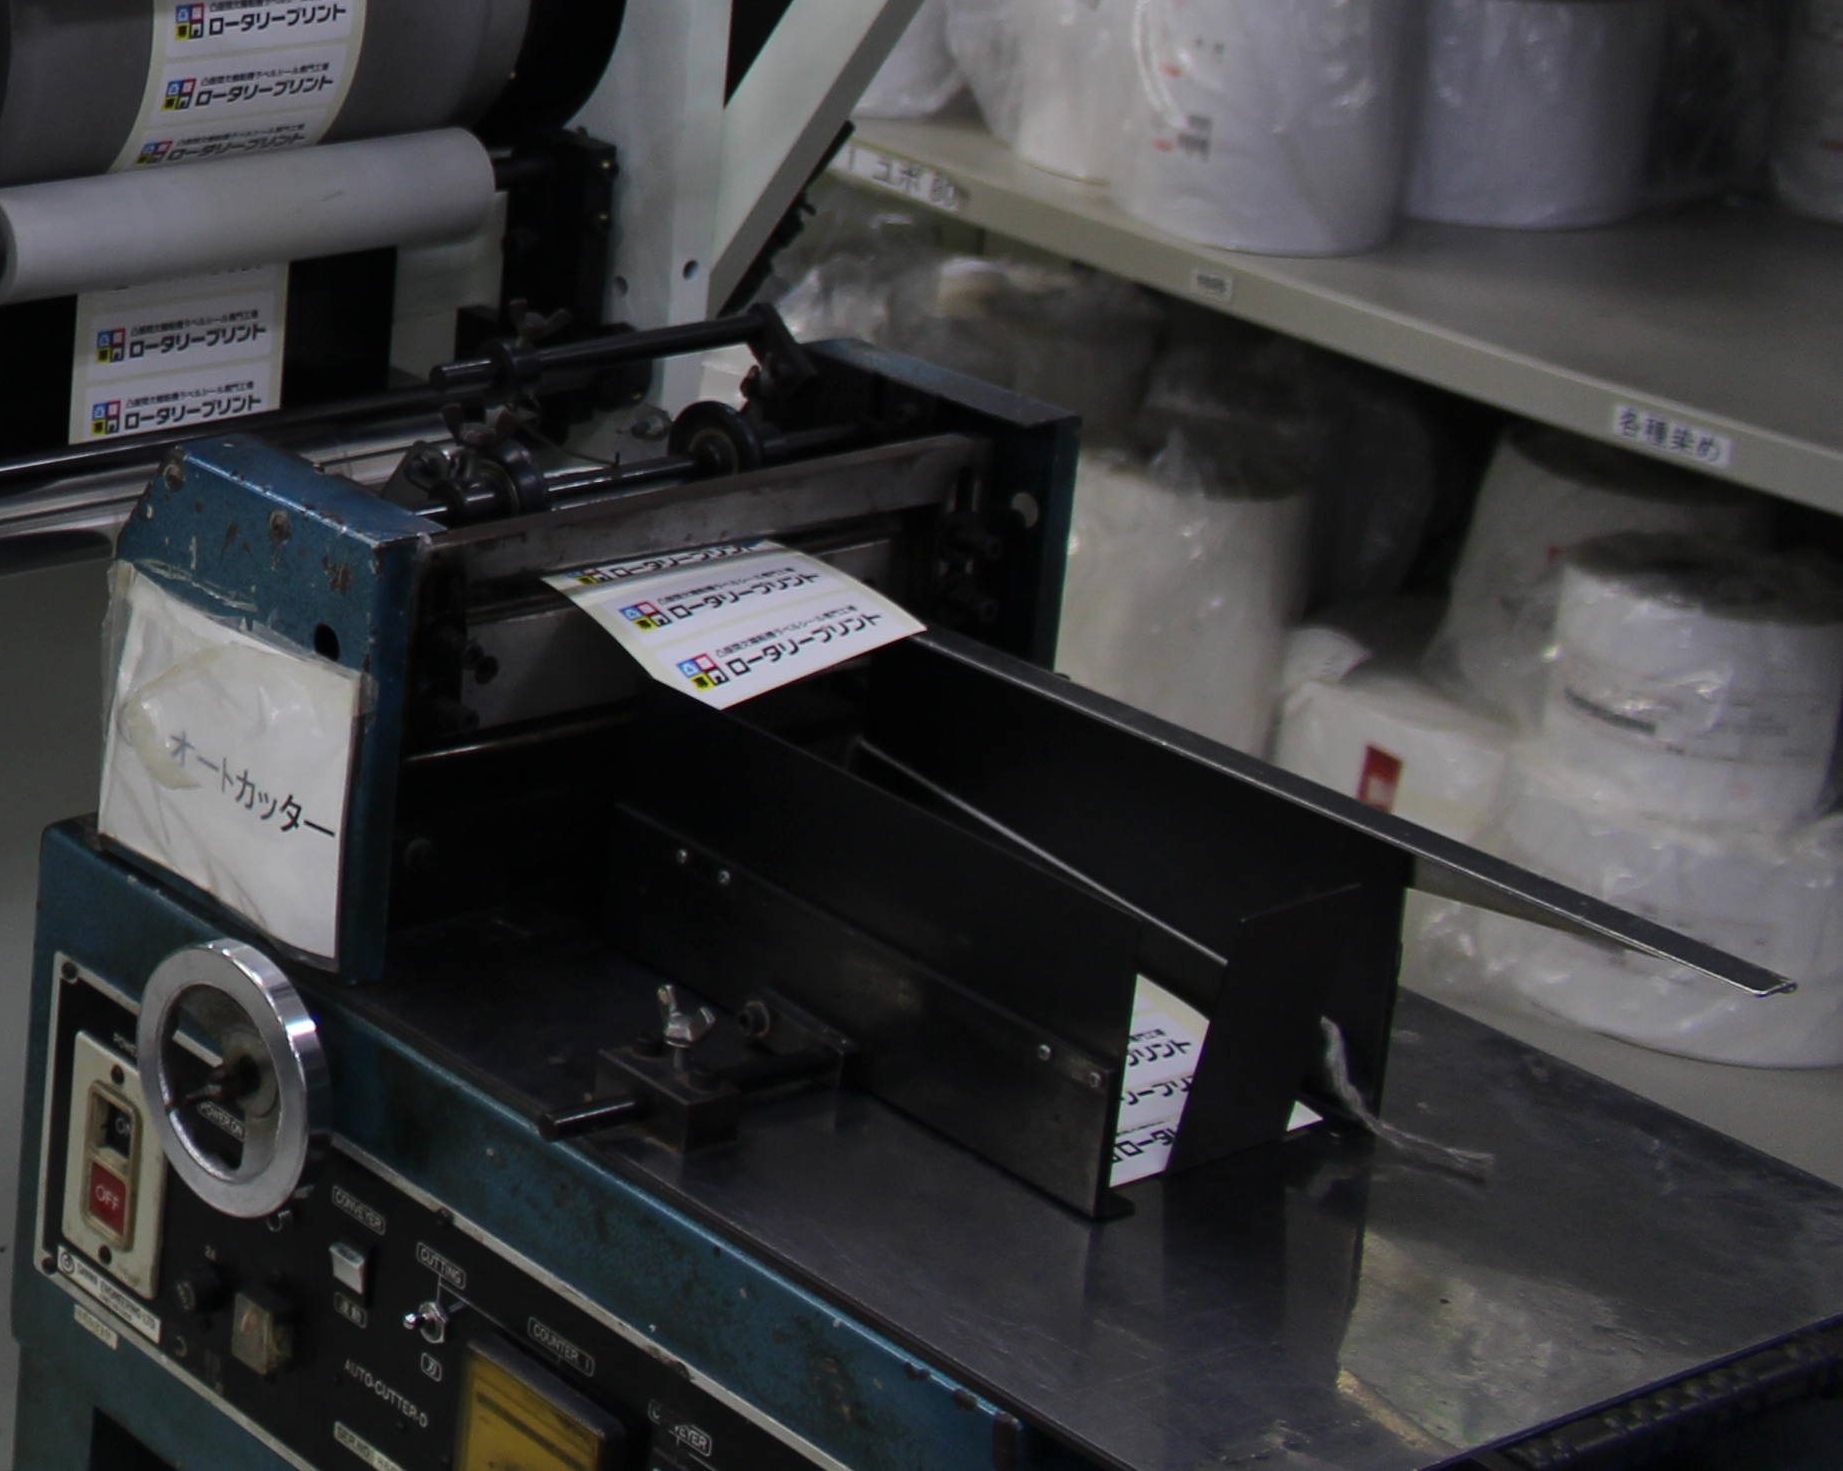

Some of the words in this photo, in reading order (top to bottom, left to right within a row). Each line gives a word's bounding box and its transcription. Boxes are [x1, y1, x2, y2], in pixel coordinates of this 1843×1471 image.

[208, 4, 347, 36] ロータリープリント
[194, 75, 334, 107] ロータリープリント
[166, 132, 306, 163] ロータリープリント
[129, 323, 266, 359] ロータリープリント
[124, 394, 262, 430] ロータリープリント
[668, 570, 821, 620] ロータリープリント
[726, 609, 883, 676] ロータリープリント
[170, 731, 335, 838] オートカッター
[95, 1184, 120, 1210] OFF
[336, 1189, 383, 1230] CONVEYER
[420, 1247, 462, 1288] CUTTING
[533, 1323, 579, 1362] COUNTER
[344, 1359, 429, 1428] AUTO-CUTTER-D
